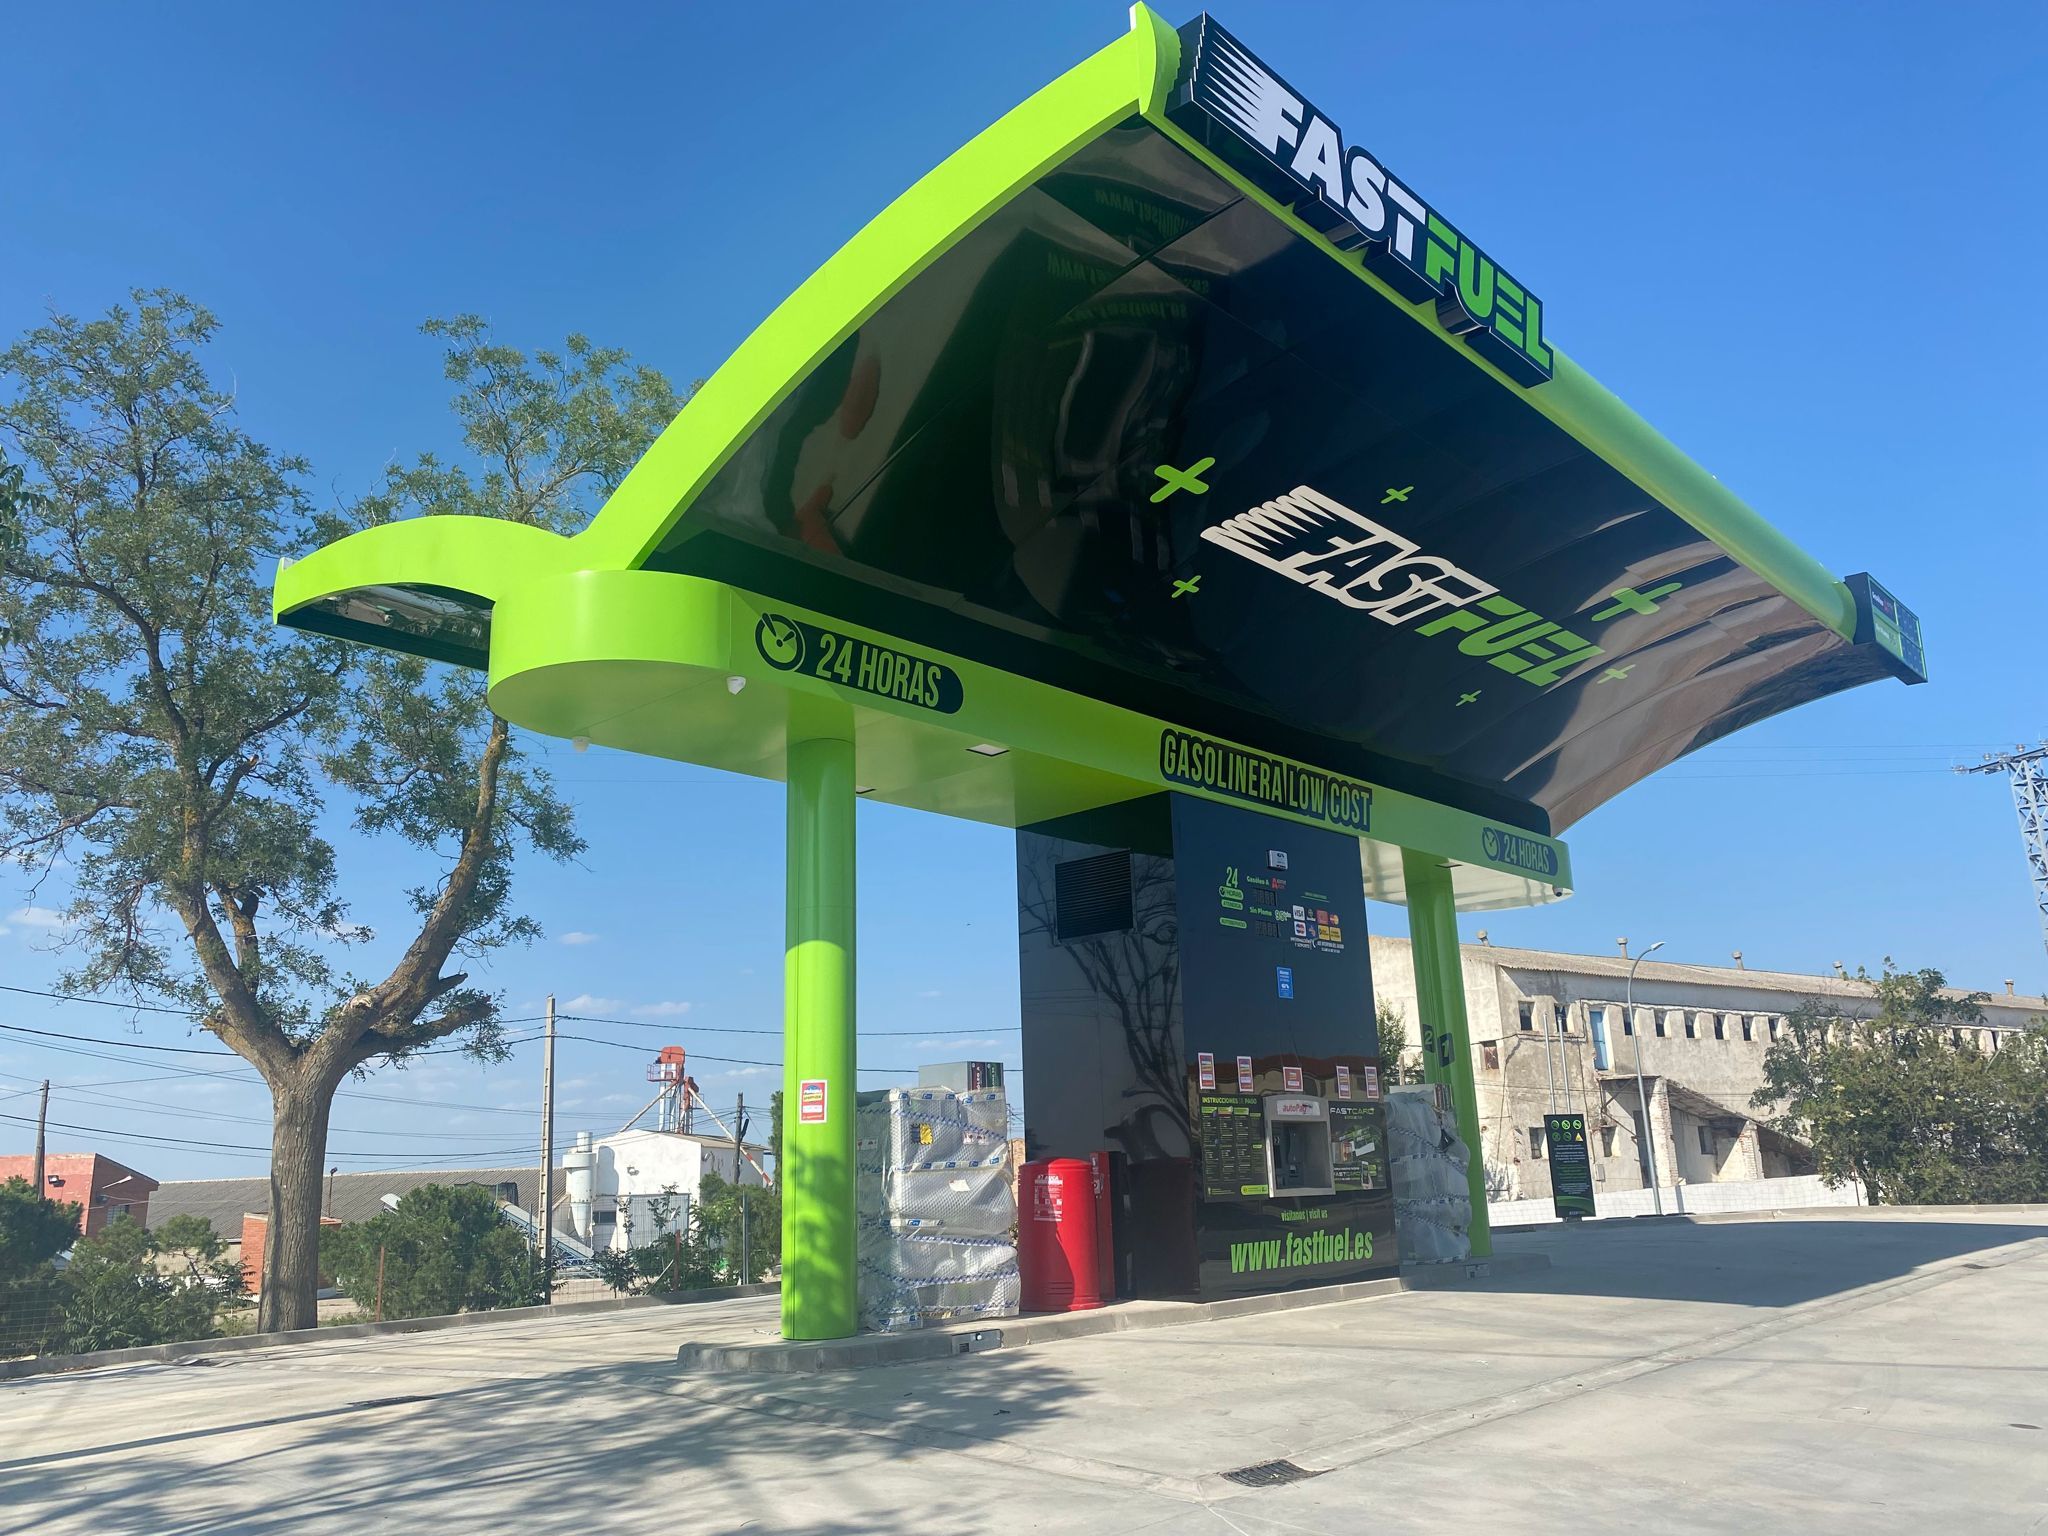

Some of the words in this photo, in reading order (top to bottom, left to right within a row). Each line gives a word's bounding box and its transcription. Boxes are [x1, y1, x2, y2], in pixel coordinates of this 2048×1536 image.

[815, 633, 853, 683] 24
[857, 644, 942, 708] HORAS
[1164, 734, 1283, 804] GASOLINERA
[1289, 770, 1325, 814] LOW
[1329, 782, 1370, 826] COST
[1503, 834, 1517, 865] 24
[1519, 840, 1549, 873] HORAS
[1226, 866, 1238, 888] 24
[1424, 1030, 1433, 1045] 2
[1441, 1040, 1450, 1057] 1
[1230, 1227, 1373, 1273] www.fastfuel.es
